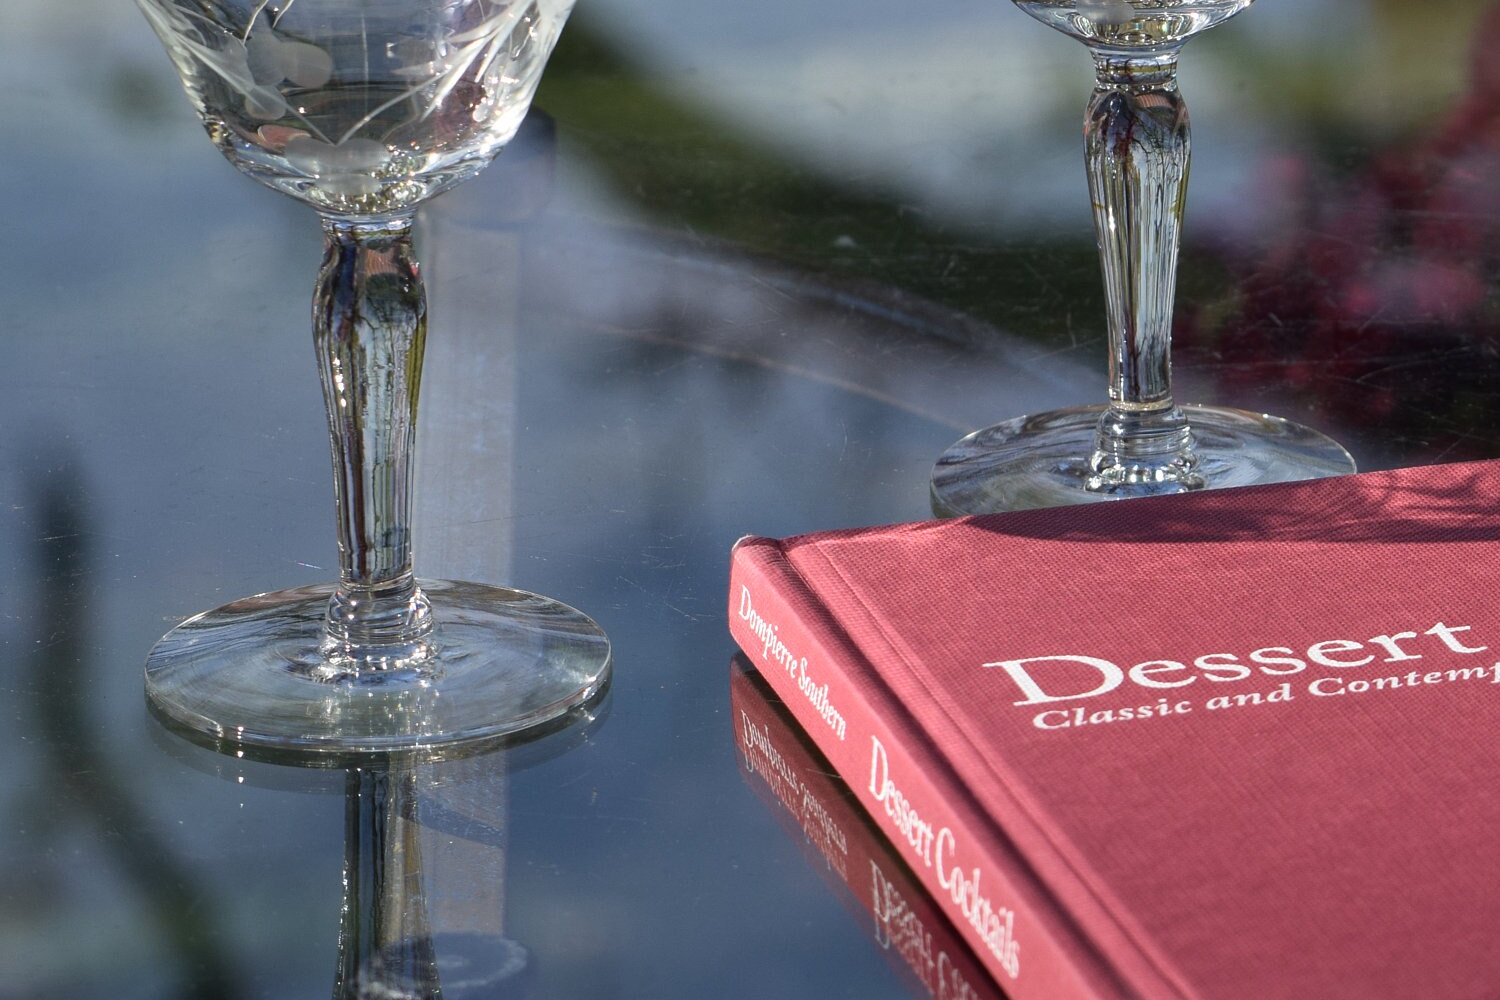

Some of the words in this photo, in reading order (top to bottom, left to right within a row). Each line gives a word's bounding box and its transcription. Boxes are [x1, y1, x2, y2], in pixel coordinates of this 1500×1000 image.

[738, 584, 798, 679] Dompierre
[798, 657, 847, 741] Southern
[981, 621, 1489, 706] Dessert
[1032, 697, 1193, 730] Classic
[1205, 682, 1295, 711] and
[868, 735, 934, 867] Dessert
[934, 827, 1021, 980] Cocktails
